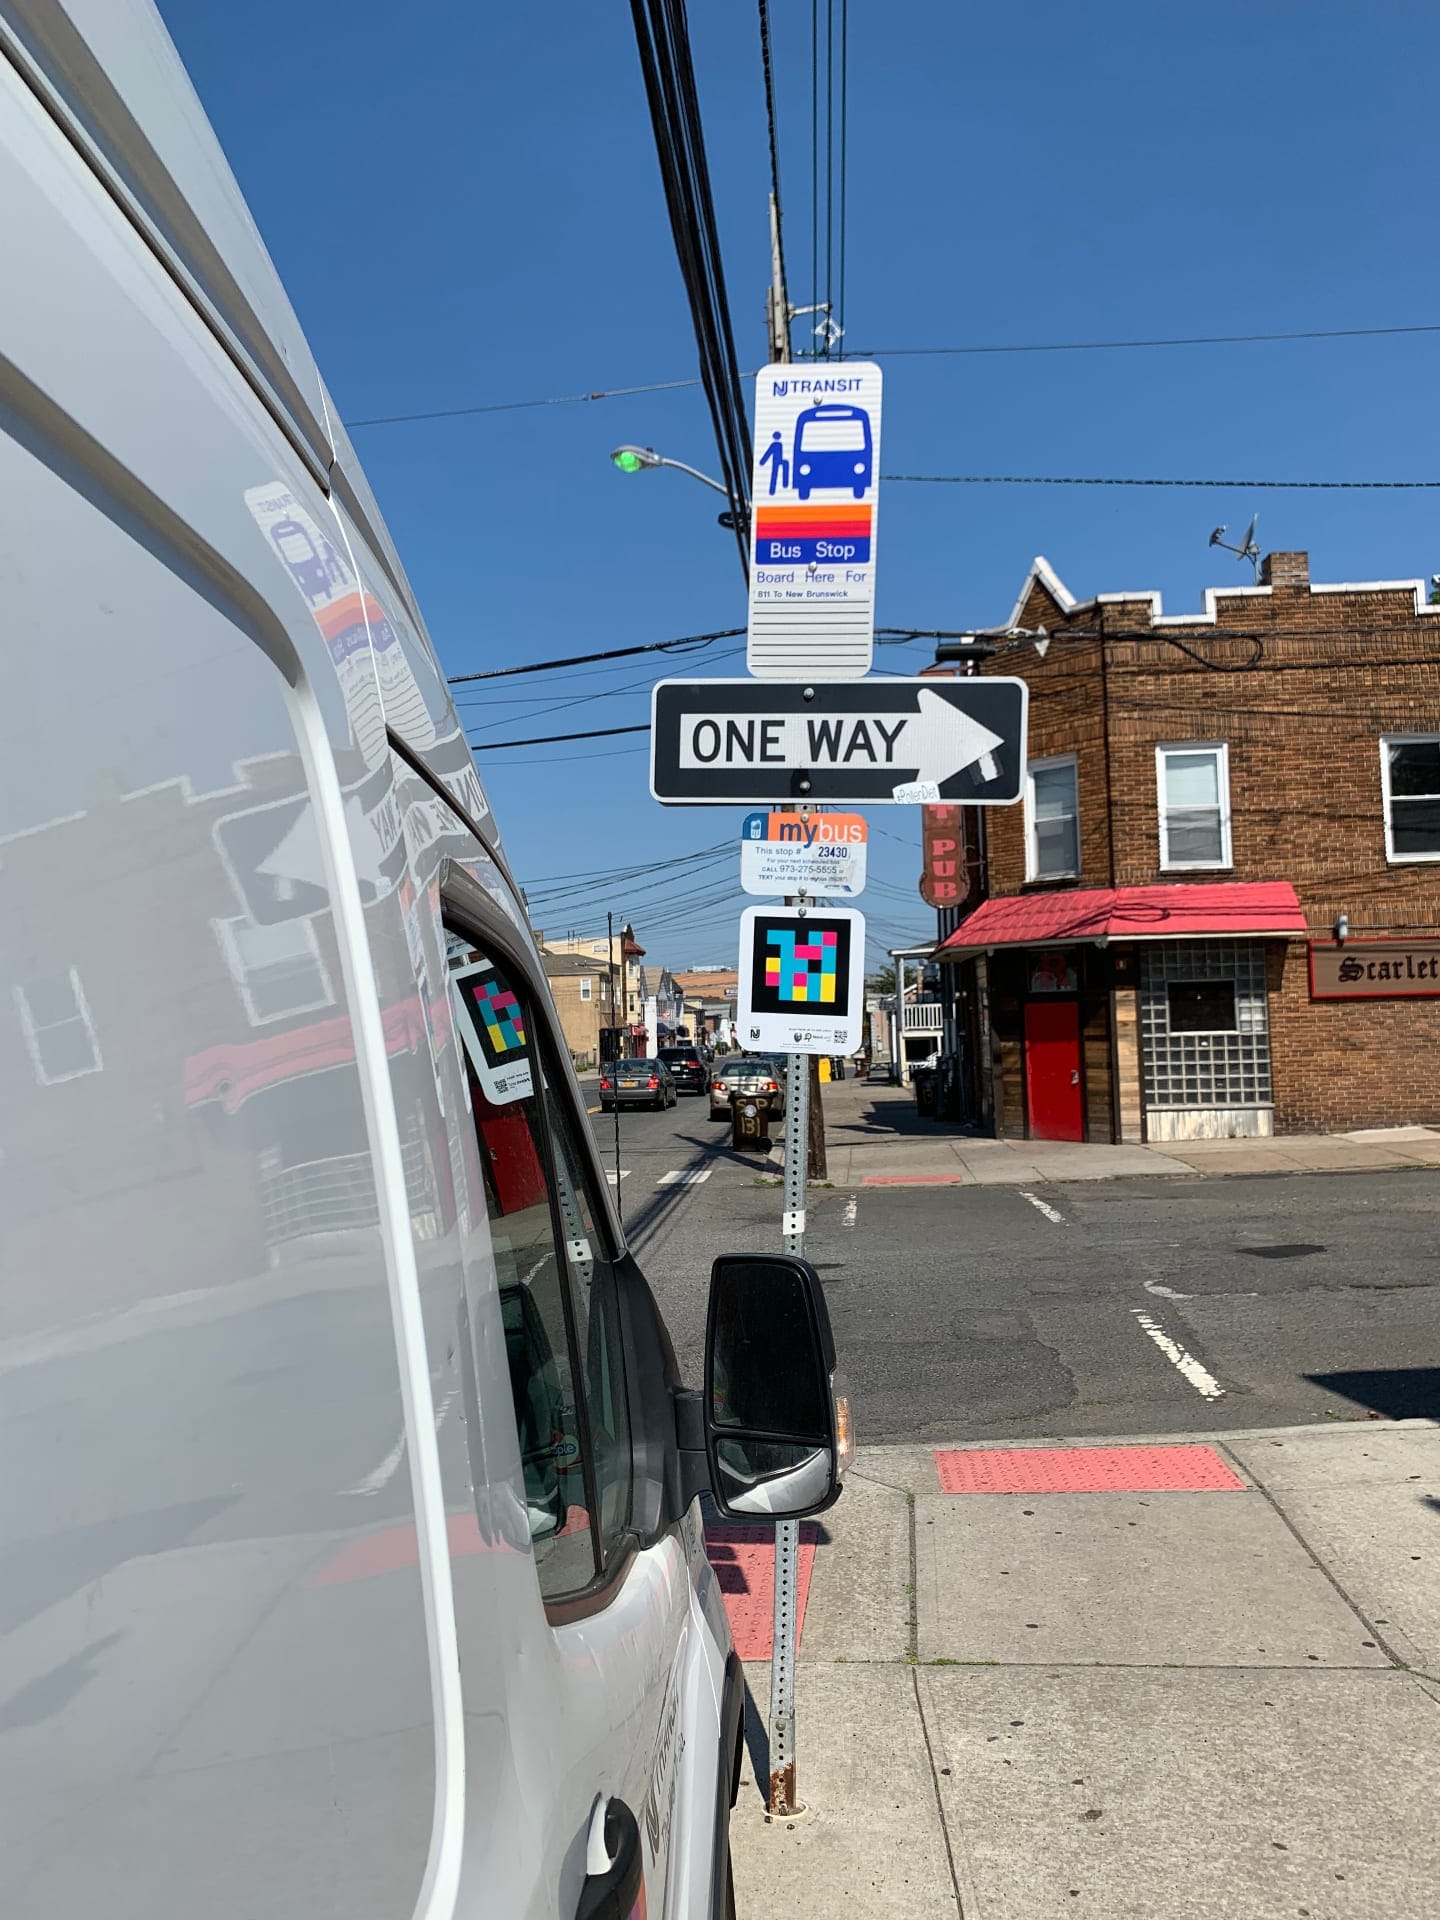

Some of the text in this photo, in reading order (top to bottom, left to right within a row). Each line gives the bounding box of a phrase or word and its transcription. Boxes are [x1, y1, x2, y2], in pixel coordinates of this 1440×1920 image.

[790, 379, 863, 393] TRANSIT
[770, 541, 855, 560] Bus Stop
[757, 570, 867, 583] Board Here For
[807, 590, 848, 598] Brunswick
[692, 720, 908, 762] ONE WAY
[780, 818, 863, 848] mybus
[775, 847, 793, 856] stop
[818, 846, 848, 857] 23430
[780, 865, 837, 873] 973-275-5555
[932, 839, 957, 898] PUB
[1338, 955, 1439, 982] Scarlet
